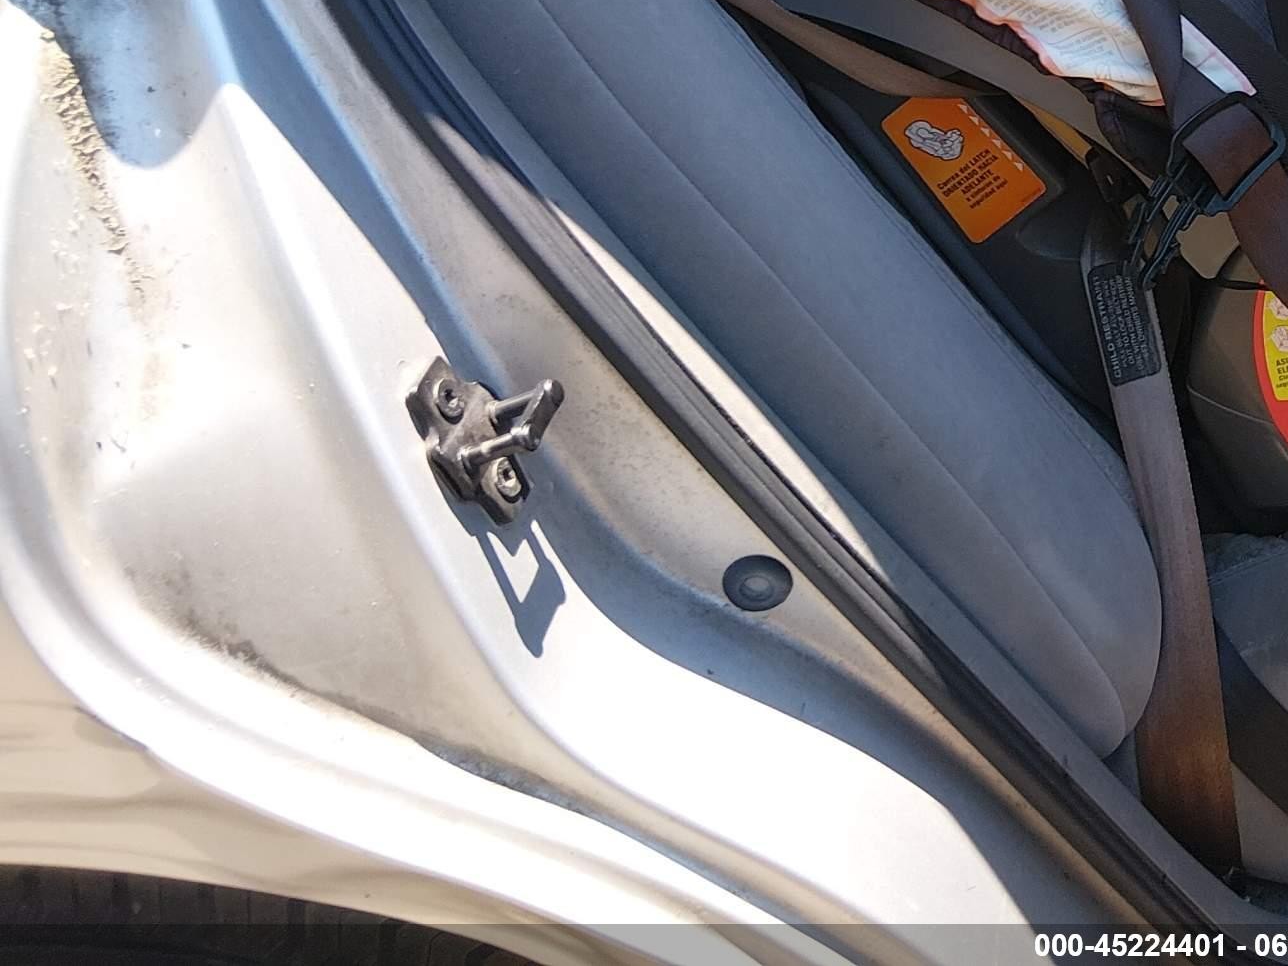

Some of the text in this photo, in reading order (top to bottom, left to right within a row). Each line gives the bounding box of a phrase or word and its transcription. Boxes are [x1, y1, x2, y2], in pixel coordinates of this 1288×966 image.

[942, 154, 998, 197] ORIENTADO HACIA
[959, 163, 971, 173] del
[968, 149, 991, 166] LATCH
[961, 168, 993, 195] ADELANTE
[1107, 343, 1122, 378] CHILD
